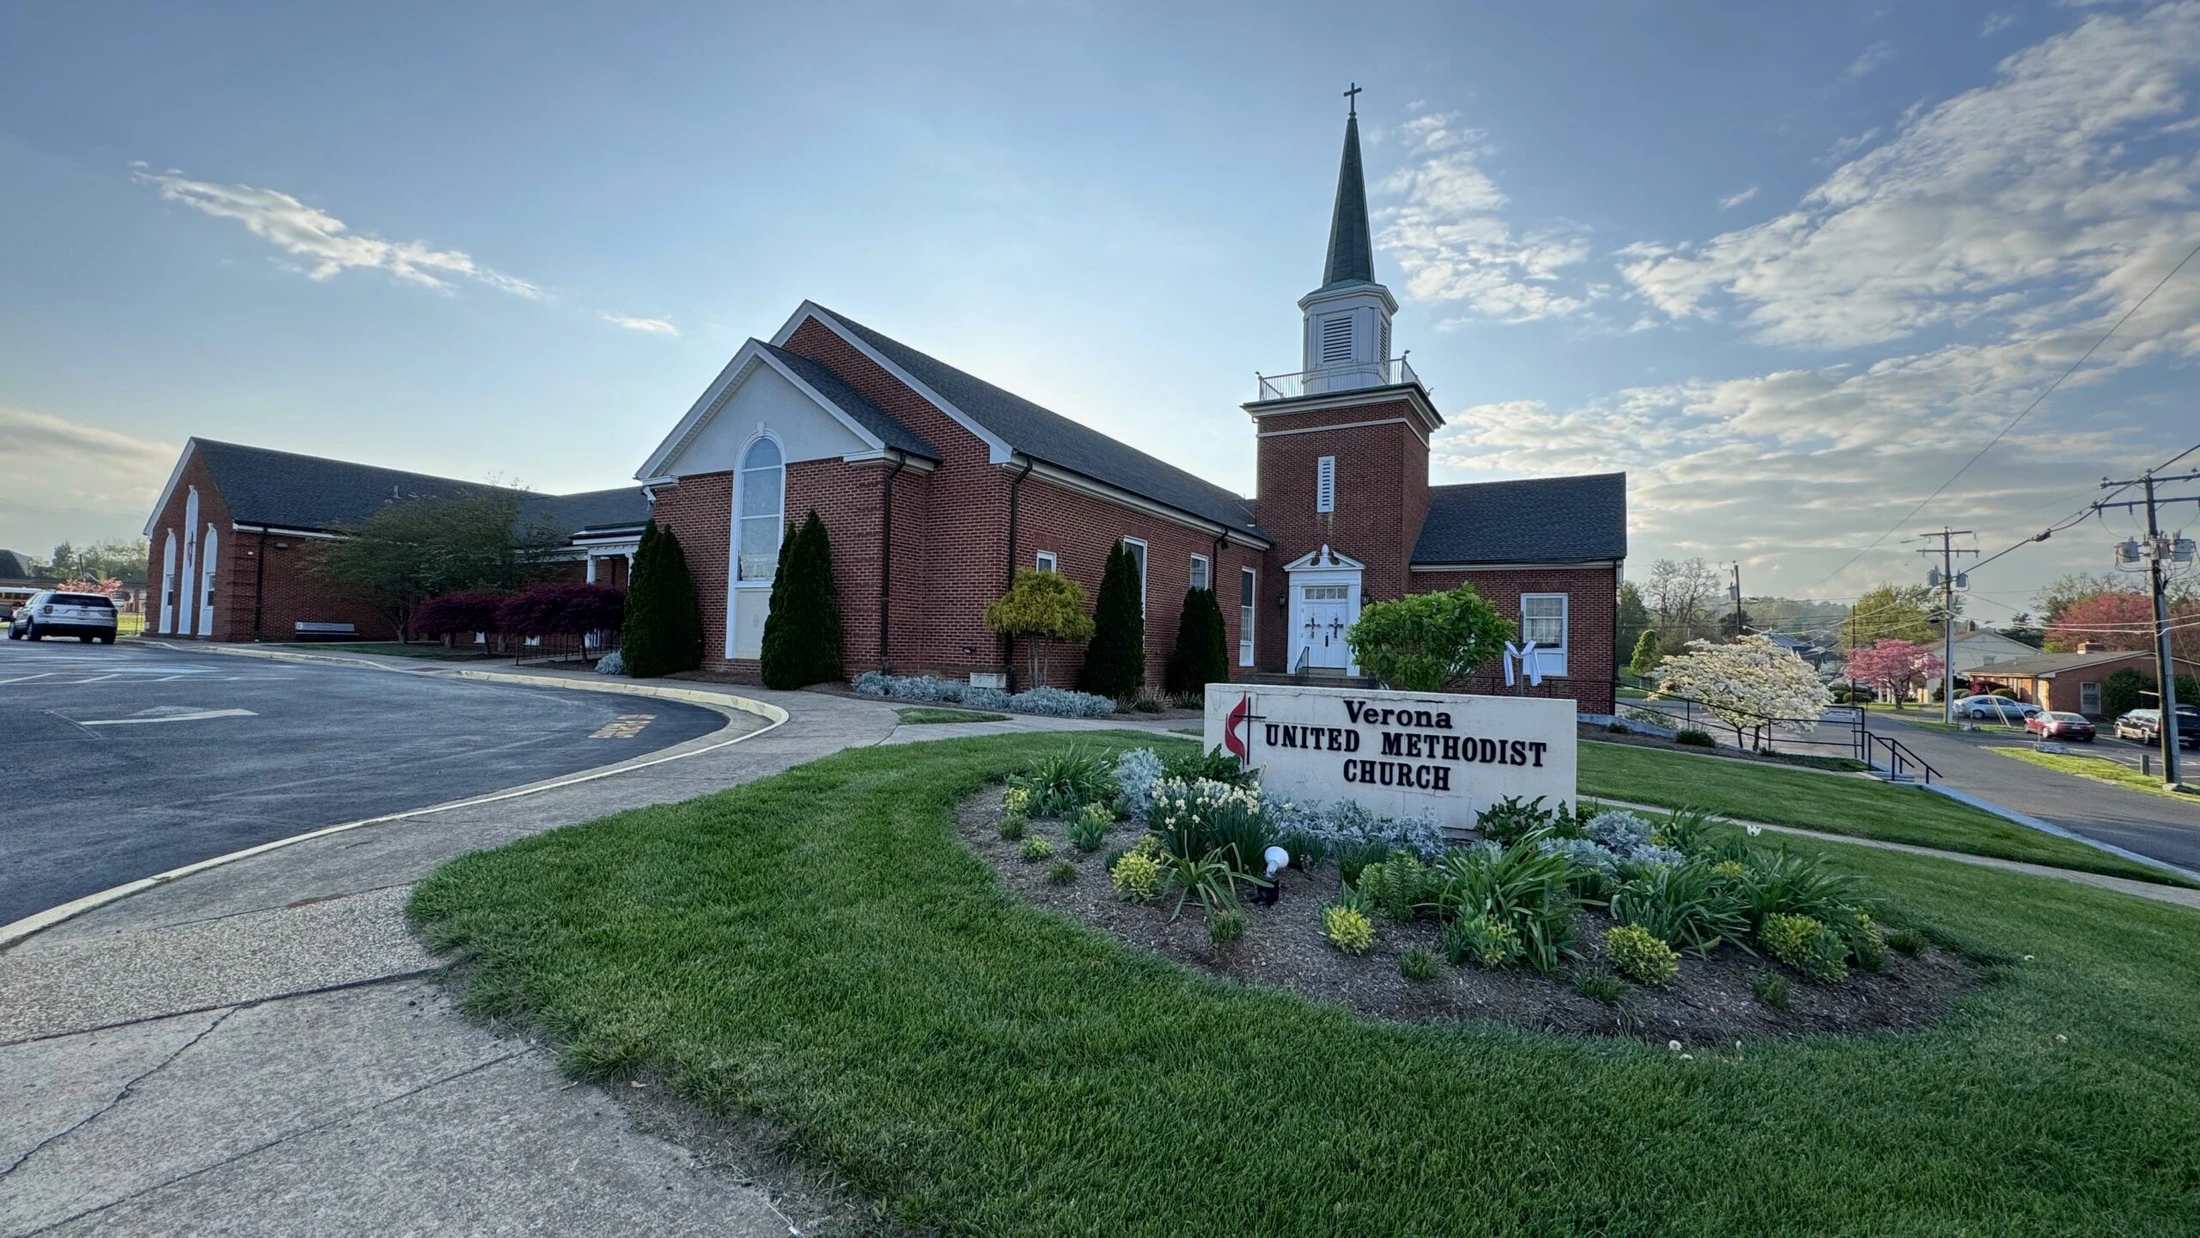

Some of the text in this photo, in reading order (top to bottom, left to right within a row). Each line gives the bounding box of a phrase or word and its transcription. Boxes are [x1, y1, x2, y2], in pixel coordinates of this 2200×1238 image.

[1343, 699, 1453, 730] Verona
[1265, 724, 1547, 767] UNITED METHODIST
[1343, 758, 1451, 791] CHURCH
